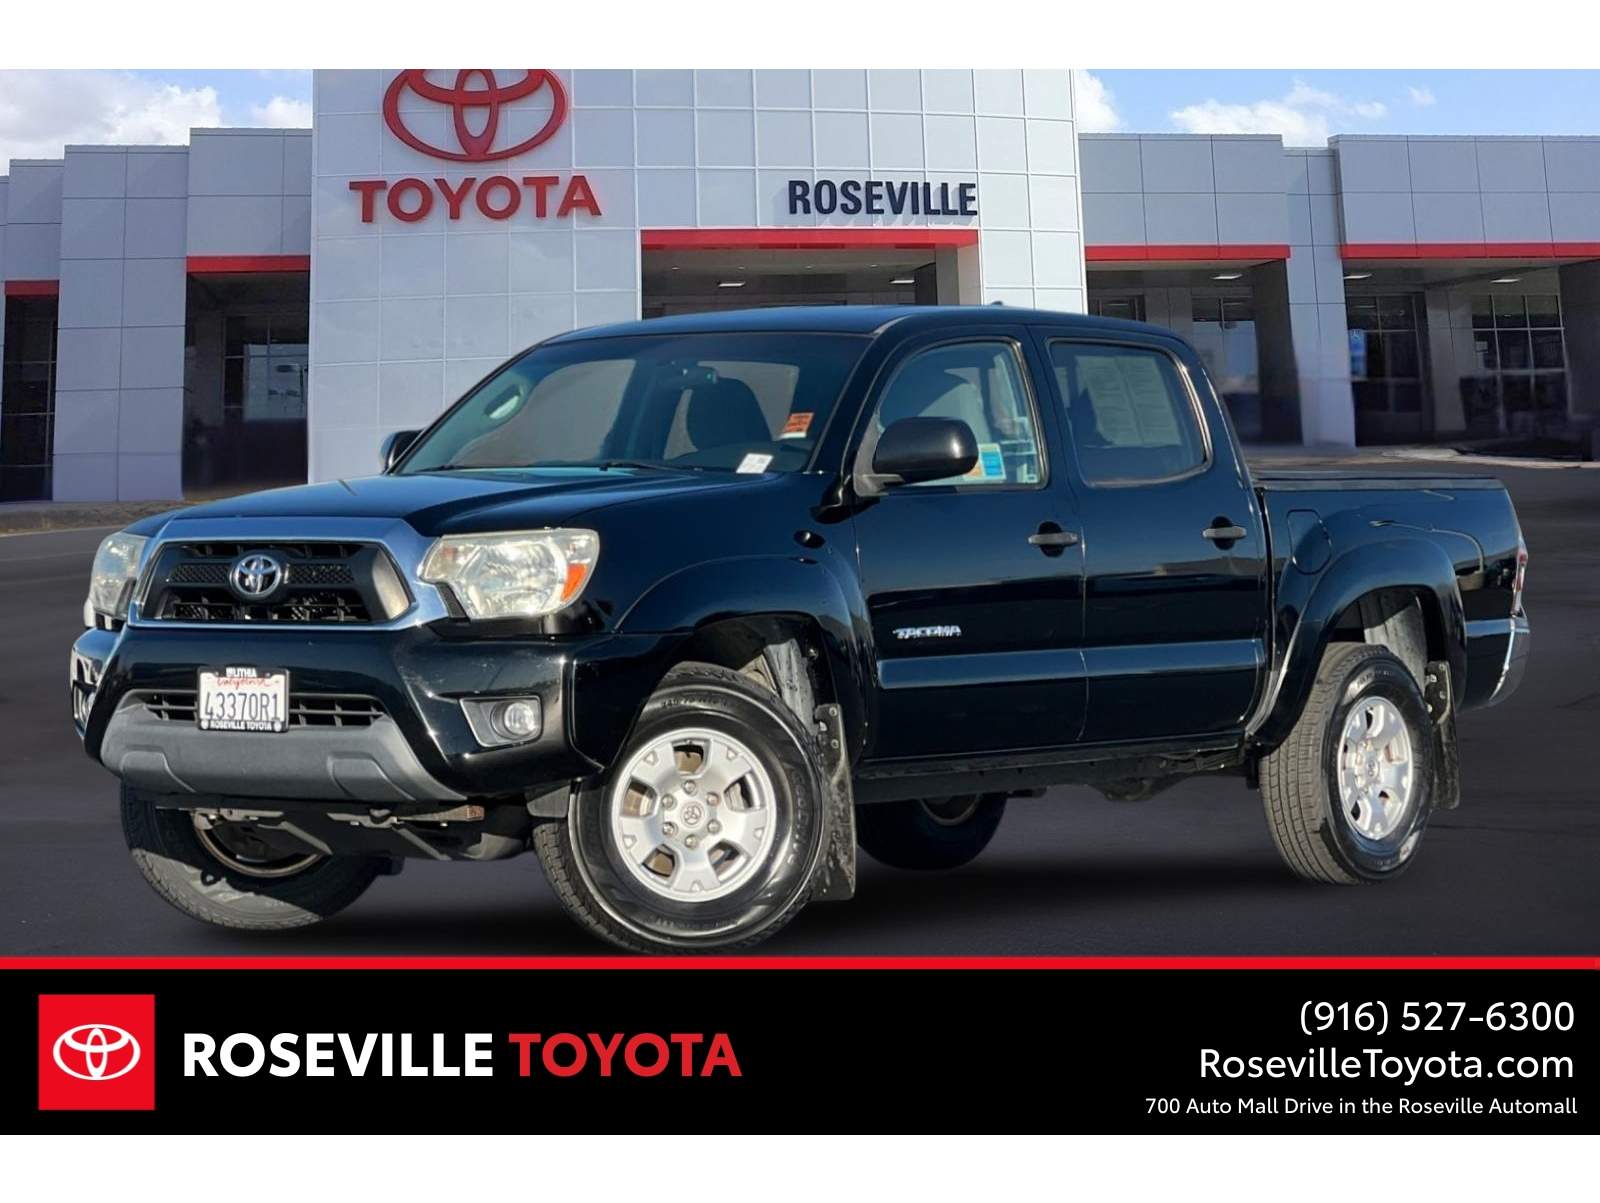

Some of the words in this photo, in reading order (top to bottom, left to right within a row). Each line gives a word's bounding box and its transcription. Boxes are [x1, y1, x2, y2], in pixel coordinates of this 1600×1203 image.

[350, 175, 602, 223] TOYOTA
[788, 179, 978, 216] ROSEVILLE
[893, 625, 962, 639] TACOMA
[205, 692, 278, 721] 43370R1
[246, 721, 272, 731] TOYOTA
